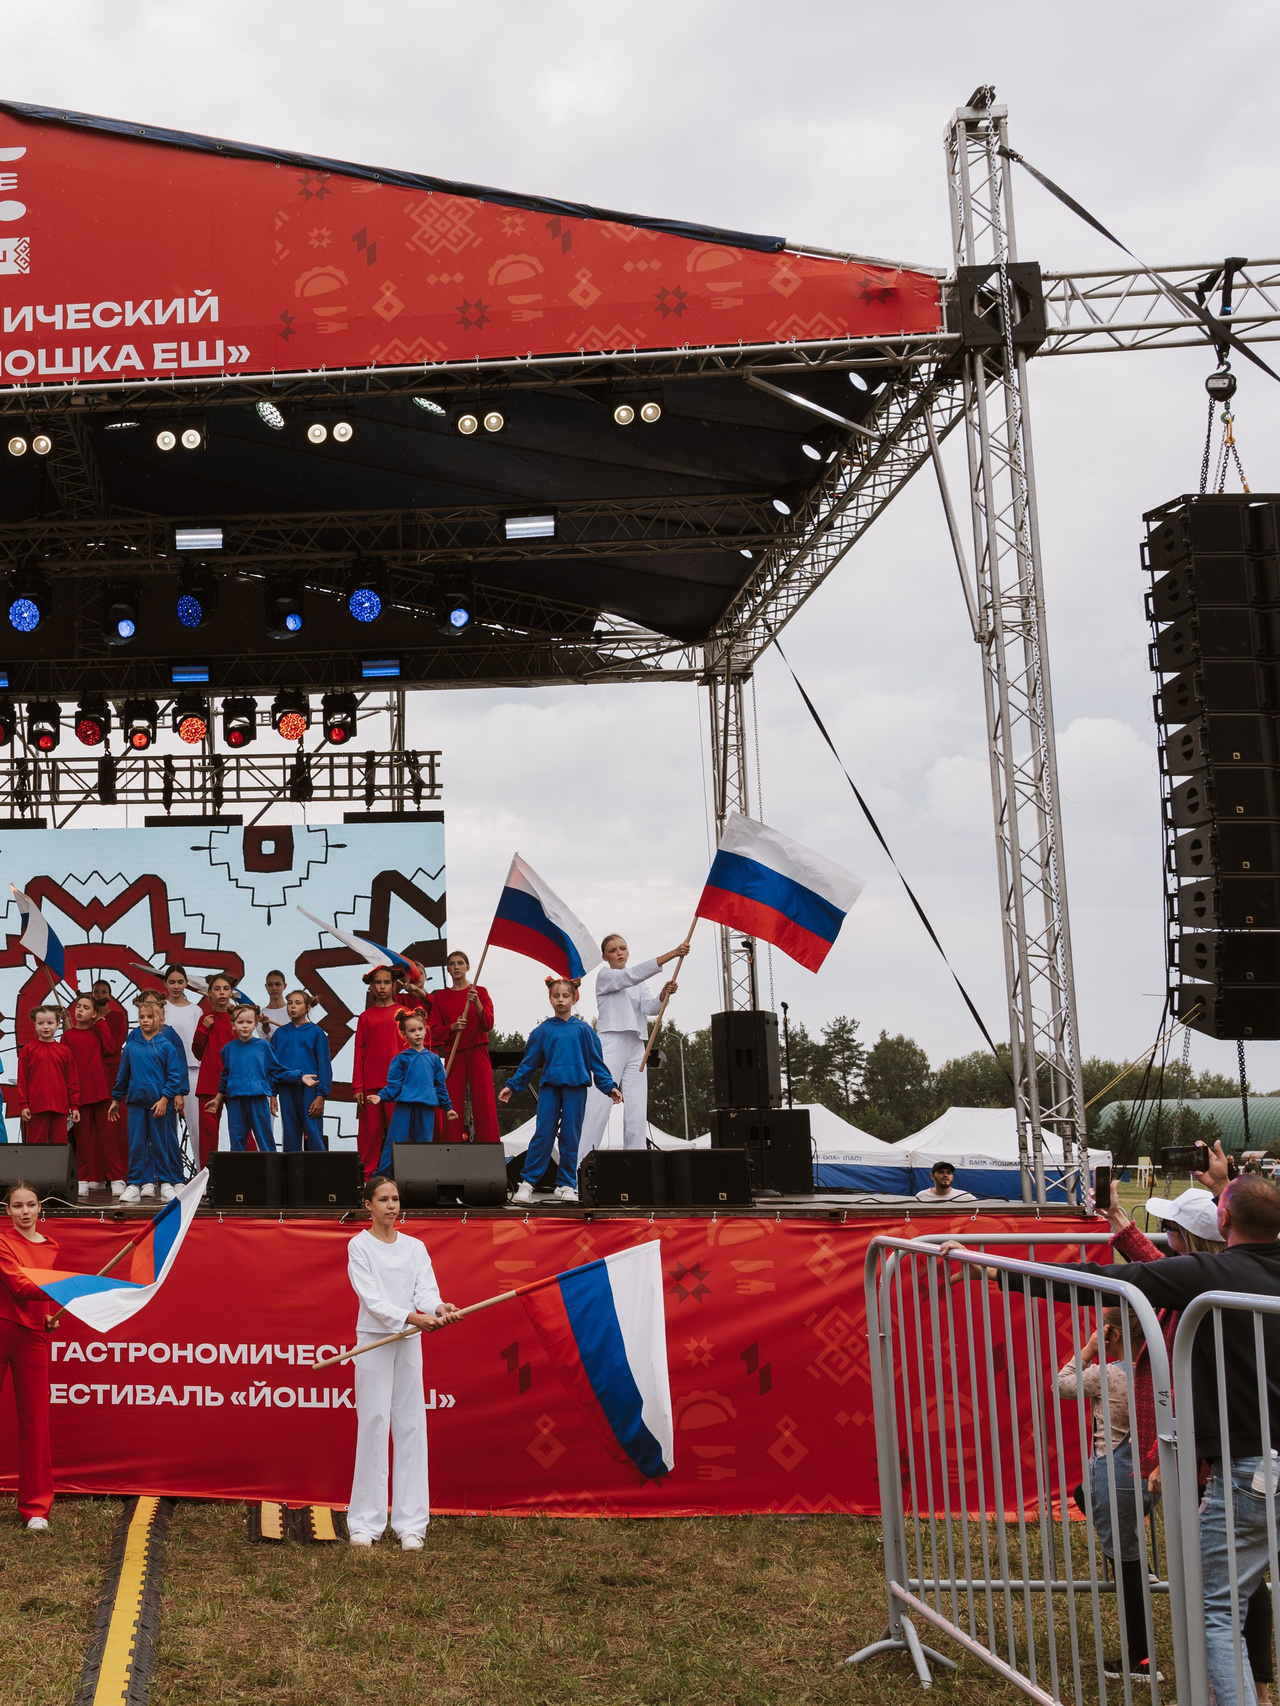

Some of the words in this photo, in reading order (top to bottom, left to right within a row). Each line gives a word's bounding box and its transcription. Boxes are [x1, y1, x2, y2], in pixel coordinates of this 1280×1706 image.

[152, 339, 251, 370] ЕШ»
[49, 1383, 225, 1407] ЕСТИВАЛЬ
[230, 1380, 358, 1408] «ЙОШК
